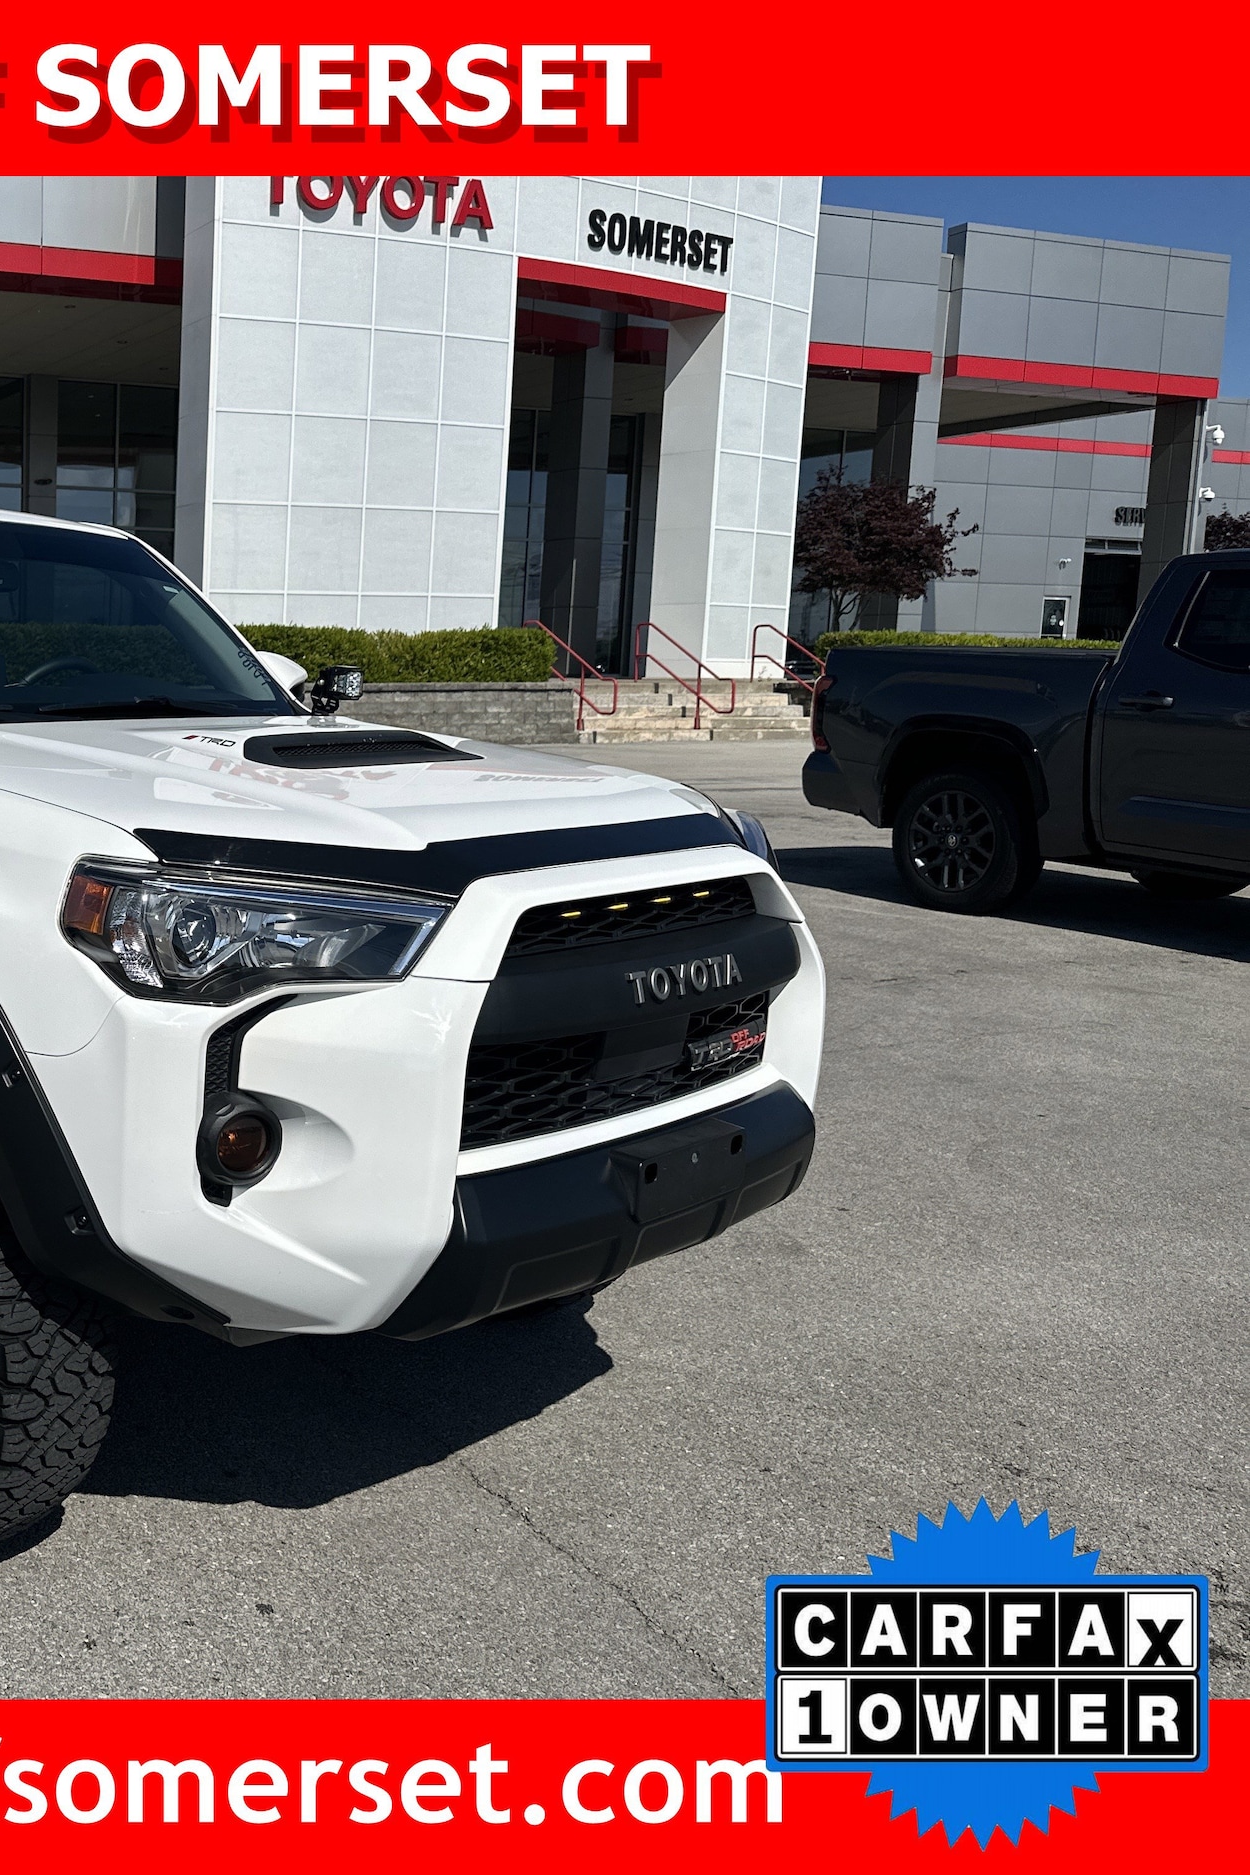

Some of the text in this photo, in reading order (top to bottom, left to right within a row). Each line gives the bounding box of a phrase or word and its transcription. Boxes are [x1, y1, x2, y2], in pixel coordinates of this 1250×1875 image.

[268, 176, 494, 230] TOYOTA
[587, 208, 734, 273] SOMERSET
[624, 953, 743, 1005] TOYOTA
